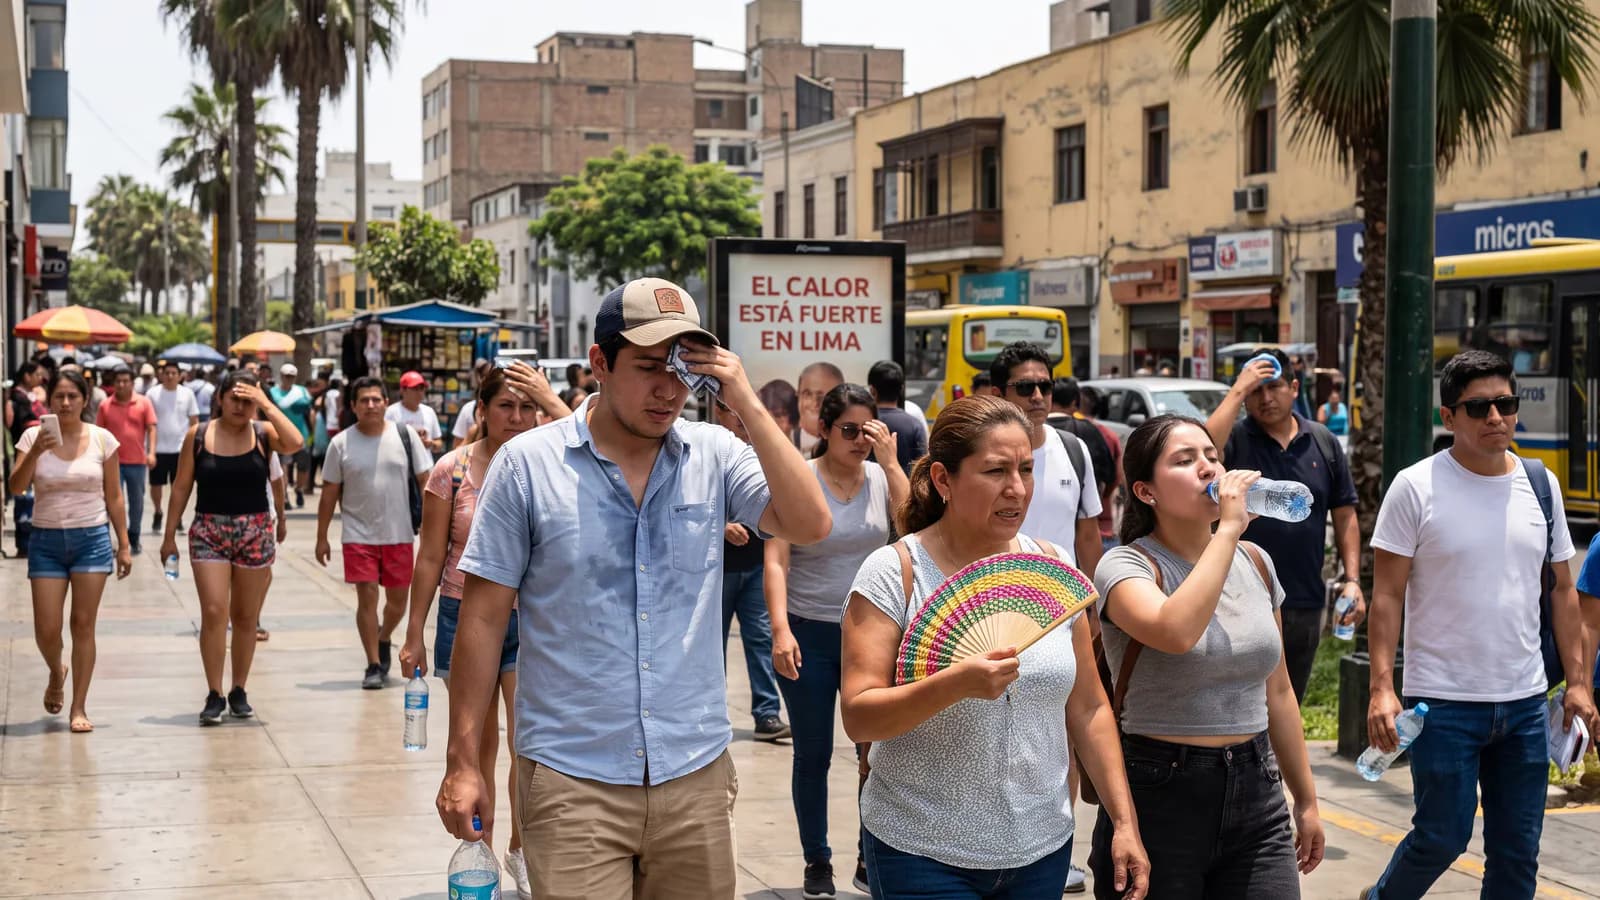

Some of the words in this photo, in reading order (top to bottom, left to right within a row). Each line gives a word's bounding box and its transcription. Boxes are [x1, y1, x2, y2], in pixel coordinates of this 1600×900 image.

[1475, 216, 1556, 252] micros
[752, 276, 780, 296] EL
[786, 276, 869, 298] CALOR
[740, 300, 793, 323] ESTÁ
[800, 305, 882, 324] FUERTE
[761, 331, 793, 351] EN
[801, 331, 862, 352] LIMA
